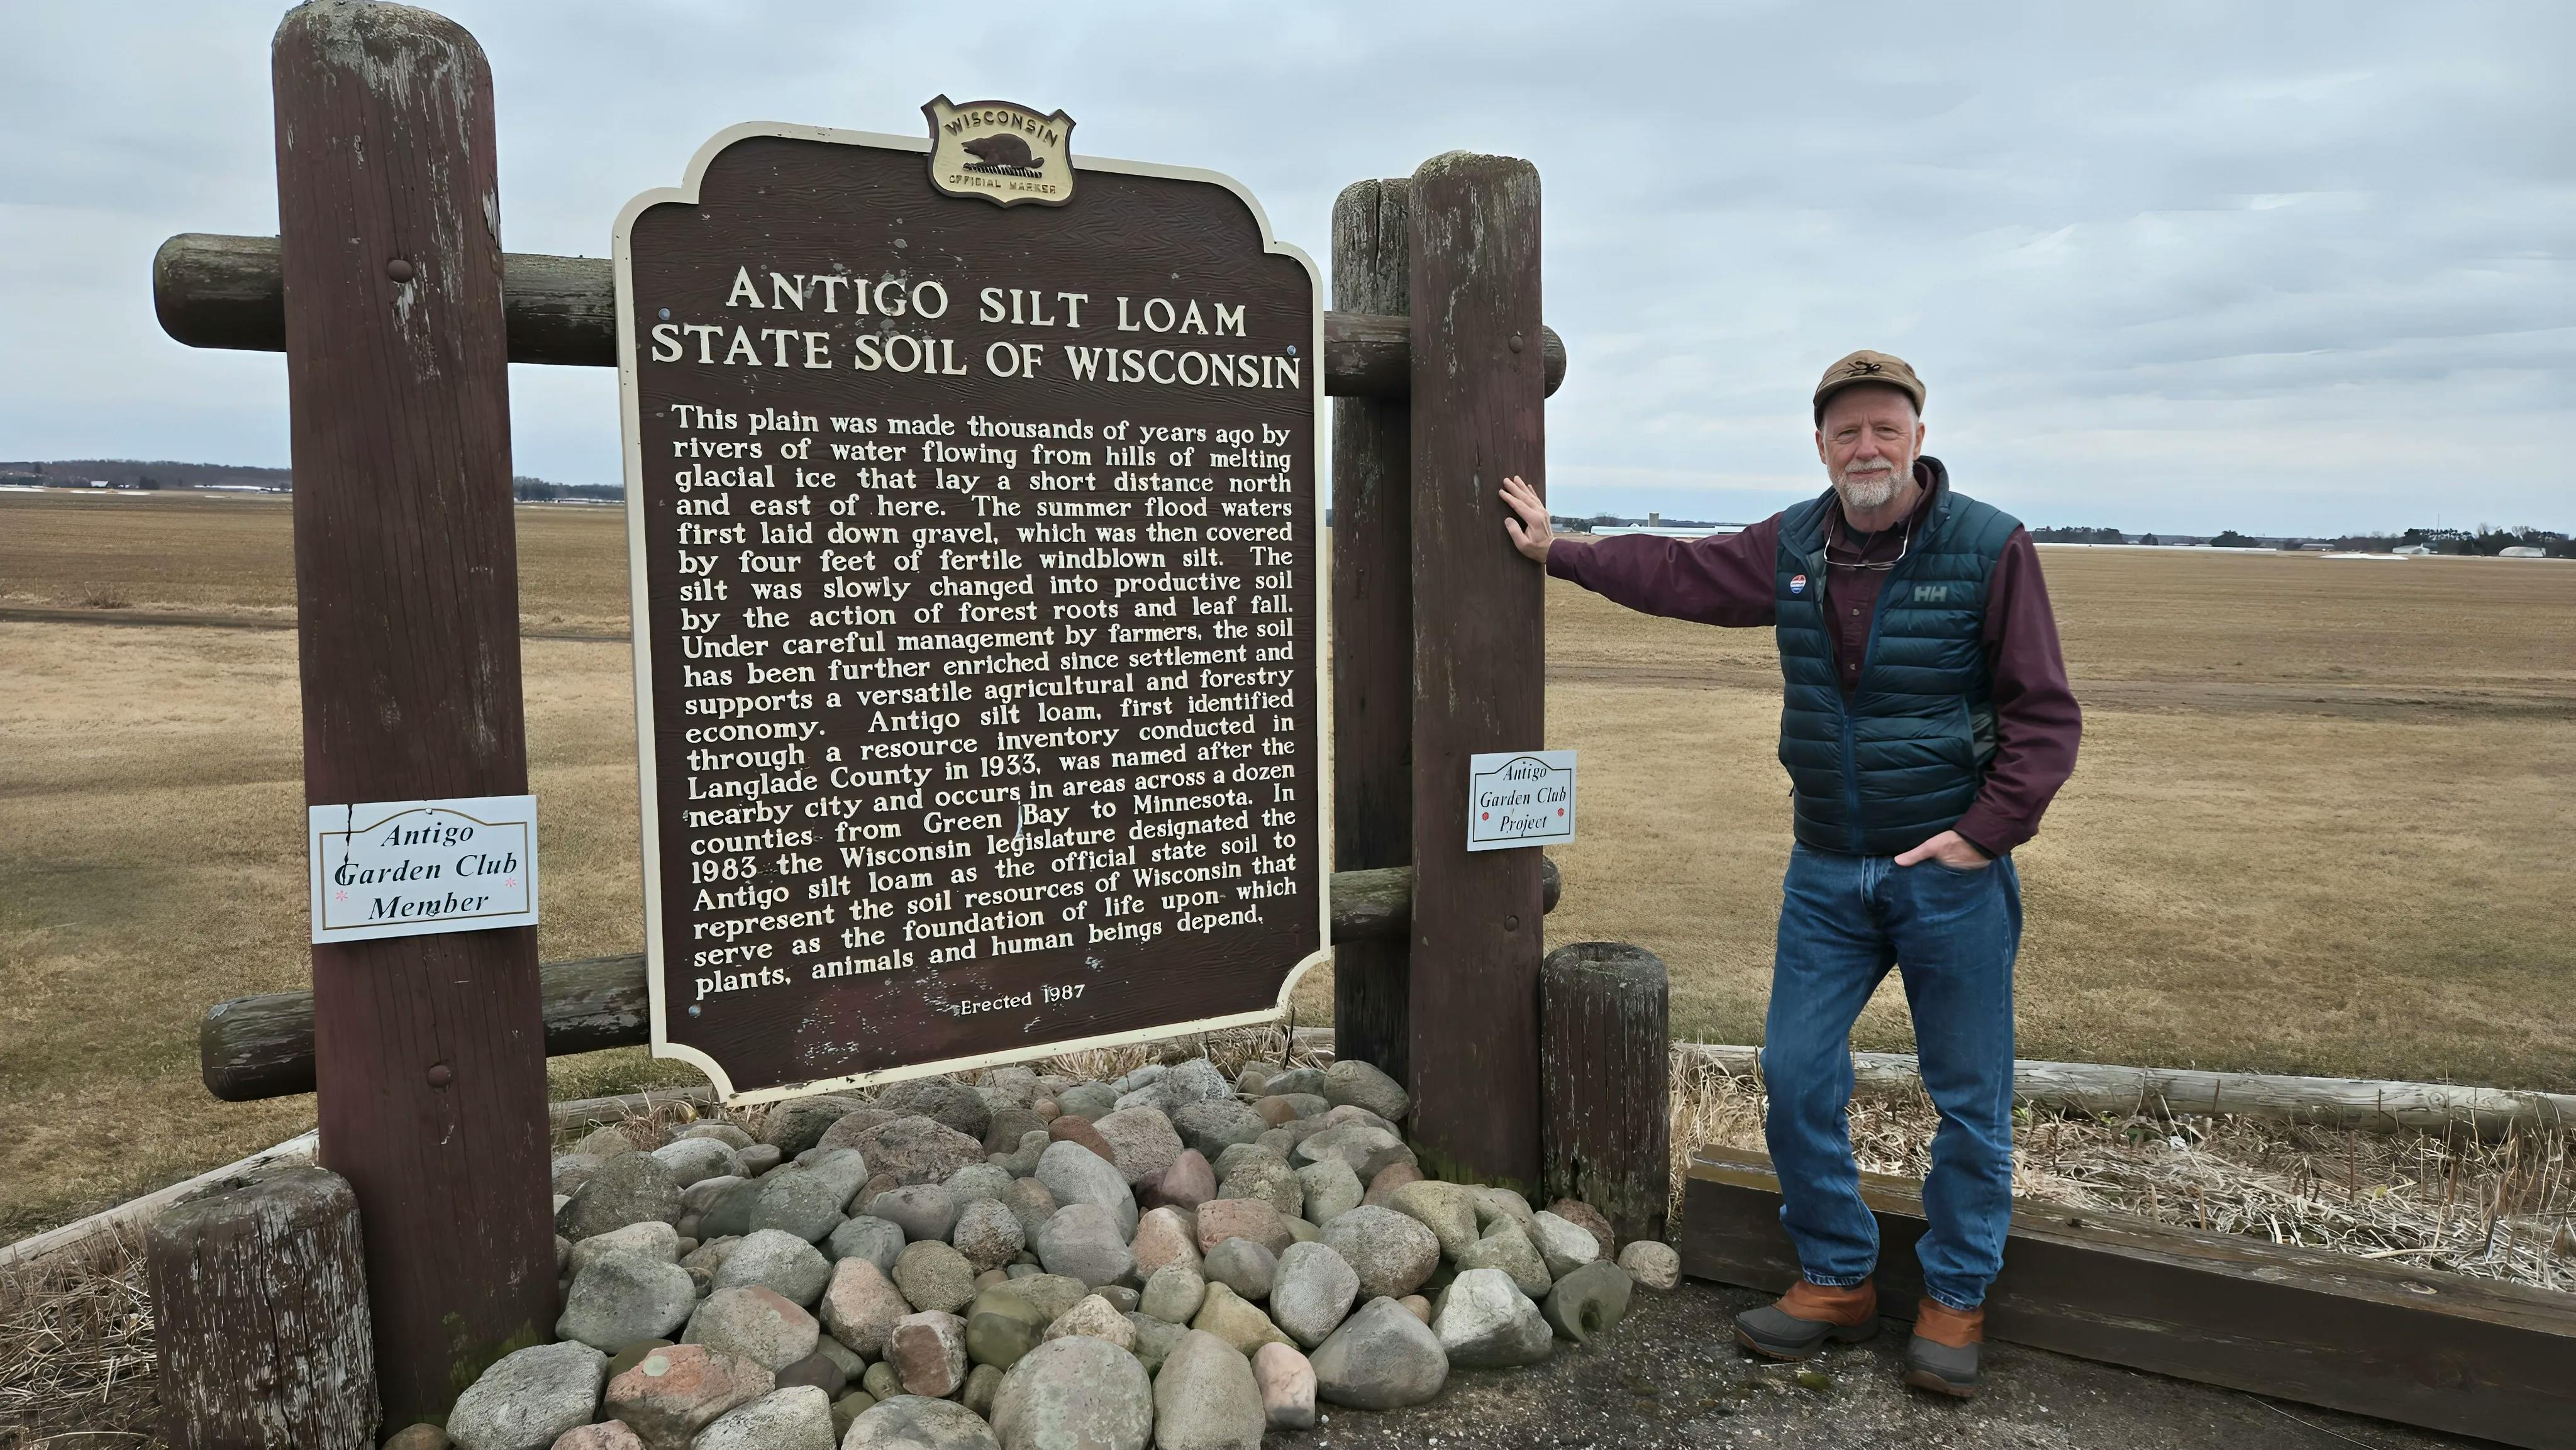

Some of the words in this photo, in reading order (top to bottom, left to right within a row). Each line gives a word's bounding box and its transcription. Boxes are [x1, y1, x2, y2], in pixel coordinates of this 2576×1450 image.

[944, 111, 1058, 148] WISCONSIN
[949, 175, 1001, 187] OFFICIAL
[725, 265, 948, 319] ANTIGO
[980, 287, 1088, 328] SILT
[1116, 297, 1246, 337] LOAM
[652, 323, 832, 369] STATE
[855, 335, 967, 376] SOIL
[986, 341, 1044, 378] OF
[1064, 345, 1301, 389] WISCONSIN
[671, 404, 737, 429] This
[748, 408, 819, 435] plain
[830, 418, 877, 433] was
[887, 414, 955, 435] made
[967, 416, 1093, 439] thousands
[1140, 426, 1206, 445] years
[1216, 429, 1253, 448] ago
[673, 438, 762, 458] rivers
[830, 441, 906, 461] water
[922, 440, 1017, 469] flowing
[1031, 443, 1091, 465] from
[1106, 446, 1155, 466] hills
[1210, 448, 1291, 473] melting
[675, 464, 775, 492] glacial
[796, 468, 835, 487] ice
[857, 468, 916, 489] that
[936, 468, 980, 494] lay
[1030, 470, 1096, 490] short
[1114, 471, 1213, 492] distance
[1230, 473, 1291, 492] north
[677, 492, 730, 515] and
[750, 495, 811, 515] east
[877, 495, 945, 516] here.
[972, 495, 1021, 516] The
[1037, 502, 1131, 516] summer
[1145, 497, 1207, 516] flood
[1221, 498, 1292, 516] waters
[677, 523, 746, 544] first
[760, 522, 813, 543] laid
[828, 522, 899, 543] down
[913, 522, 998, 549] gravel,
[1016, 523, 1086, 542] which
[1096, 528, 1136, 542] was
[1146, 522, 1197, 541] then
[1206, 522, 1292, 541] covered
[738, 550, 801, 572] four
[819, 550, 875, 572] feet
[940, 549, 1022, 570] fertile
[1039, 548, 1165, 568] windblown
[1183, 547, 1224, 567] silt.
[1250, 546, 1292, 565] The
[680, 578, 727, 601] silt
[751, 584, 802, 599] was
[824, 576, 911, 601] slowly
[930, 574, 1033, 600] changed
[1050, 575, 1097, 594] into
[1114, 572, 1240, 597] productive
[1256, 570, 1292, 589] soil
[1914, 586, 1948, 602] HH
[743, 606, 789, 628] the
[810, 606, 896, 626] action
[958, 601, 1037, 622] forest
[1053, 600, 1118, 619] roots
[1135, 596, 1177, 617] and
[1192, 595, 1236, 615] leaf
[1251, 594, 1292, 613] fall.
[682, 634, 768, 658] Under
[783, 631, 886, 654] careful
[897, 626, 1054, 653] management
[1108, 624, 1201, 643] farmers,
[1213, 619, 1247, 638] the
[1257, 617, 1292, 637] soil
[684, 665, 732, 687] has
[747, 663, 815, 683] been
[828, 658, 930, 680] further
[944, 651, 1050, 675] enriched
[1061, 652, 1118, 670] since
[1130, 645, 1246, 667] settlement
[1256, 641, 1293, 661] and
[686, 689, 812, 719] supports
[857, 680, 972, 706] versatile
[985, 673, 1133, 704] agricultural
[1147, 670, 1188, 690] and
[1200, 667, 1294, 688] forestry
[686, 722, 824, 743] economy.
[868, 711, 960, 734] Antigo
[981, 704, 1019, 725] silt
[1038, 702, 1101, 722] loam,
[1120, 697, 1172, 717] first
[1189, 689, 1294, 713] identified
[687, 743, 804, 771] through
[860, 739, 977, 760] resource
[997, 727, 1119, 750] inventory
[1140, 714, 1255, 740] conducted
[688, 770, 817, 800] Langlade
[831, 764, 932, 788] County
[981, 753, 1040, 777] 1933,
[1059, 756, 1100, 770] was
[1111, 743, 1186, 767] named
[1197, 741, 1252, 760] after
[1262, 738, 1294, 755] the
[1503, 763, 1547, 782] Antigo
[689, 800, 793, 827] nearby
[805, 796, 862, 819] city
[874, 788, 923, 812] and
[935, 787, 1020, 806] occurs
[1063, 778, 1125, 796] areas
[1135, 772, 1205, 790] across
[1233, 763, 1295, 782] dozen
[1480, 790, 1530, 807] Garden
[1537, 787, 1566, 803] Club
[380, 822, 474, 847] Antigo
[691, 829, 812, 855] counties
[835, 821, 901, 842] from
[924, 812, 1002, 833] Green
[1022, 804, 1070, 826] Bay
[1133, 789, 1252, 814] Minnesota.
[1500, 815, 1547, 836] Project
[692, 856, 757, 883] 1983
[840, 840, 971, 868] Wisconsin
[987, 827, 1116, 858] legislature
[1129, 812, 1249, 841] designated
[1261, 808, 1296, 827] the
[335, 860, 441, 886] Garden
[456, 852, 518, 877] Club
[693, 885, 789, 911] Antigo
[809, 875, 850, 899] silt
[869, 872, 933, 892] loam
[1052, 845, 1135, 872] official
[1152, 841, 1206, 861] state
[1222, 834, 1257, 854] soil
[368, 892, 489, 920] Member
[694, 904, 835, 942] represent
[908, 890, 951, 914] soil
[965, 882, 1083, 907] resources
[1133, 861, 1241, 887] Wisconsin
[1252, 854, 1296, 875] that
[694, 944, 772, 966] serve
[903, 910, 1044, 941] foundation
[1105, 895, 1144, 916] life
[1162, 891, 1219, 912] upon
[1236, 877, 1296, 899] which
[696, 966, 791, 1000] plants,
[812, 949, 913, 978] animals
[928, 938, 976, 963] and
[991, 933, 1074, 956] human
[1089, 922, 1162, 943] beings
[961, 992, 1032, 1015] Erected
[1043, 984, 1085, 1003] 1987
